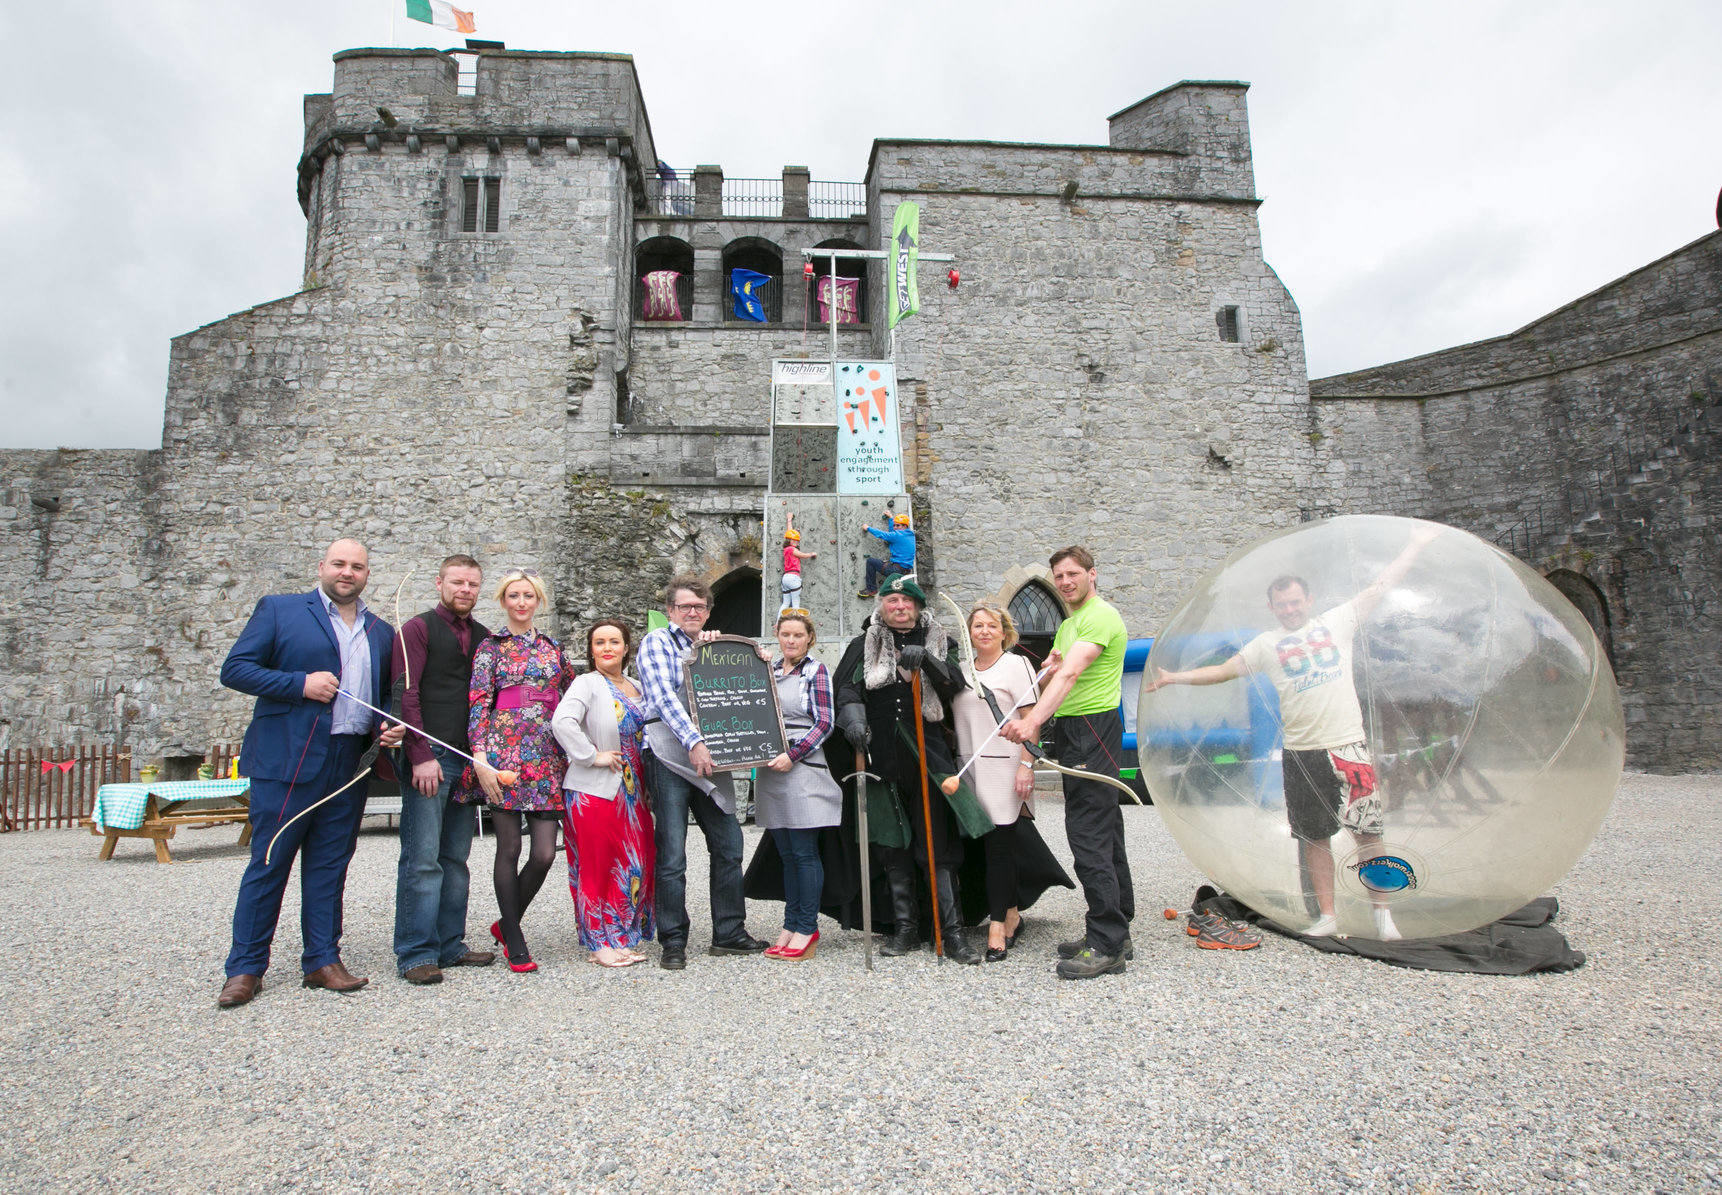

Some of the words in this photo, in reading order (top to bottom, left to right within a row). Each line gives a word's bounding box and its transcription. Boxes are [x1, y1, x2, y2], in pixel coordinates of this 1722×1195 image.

[781, 363, 828, 375] highline
[855, 447, 884, 455] youth
[840, 456, 898, 464] engagement
[851, 466, 890, 474] through
[855, 476, 882, 484] sport
[1275, 626, 1341, 678] 68
[693, 674, 746, 690] BURRITO
[700, 718, 728, 731] GUAC
[731, 716, 754, 730] BOX
